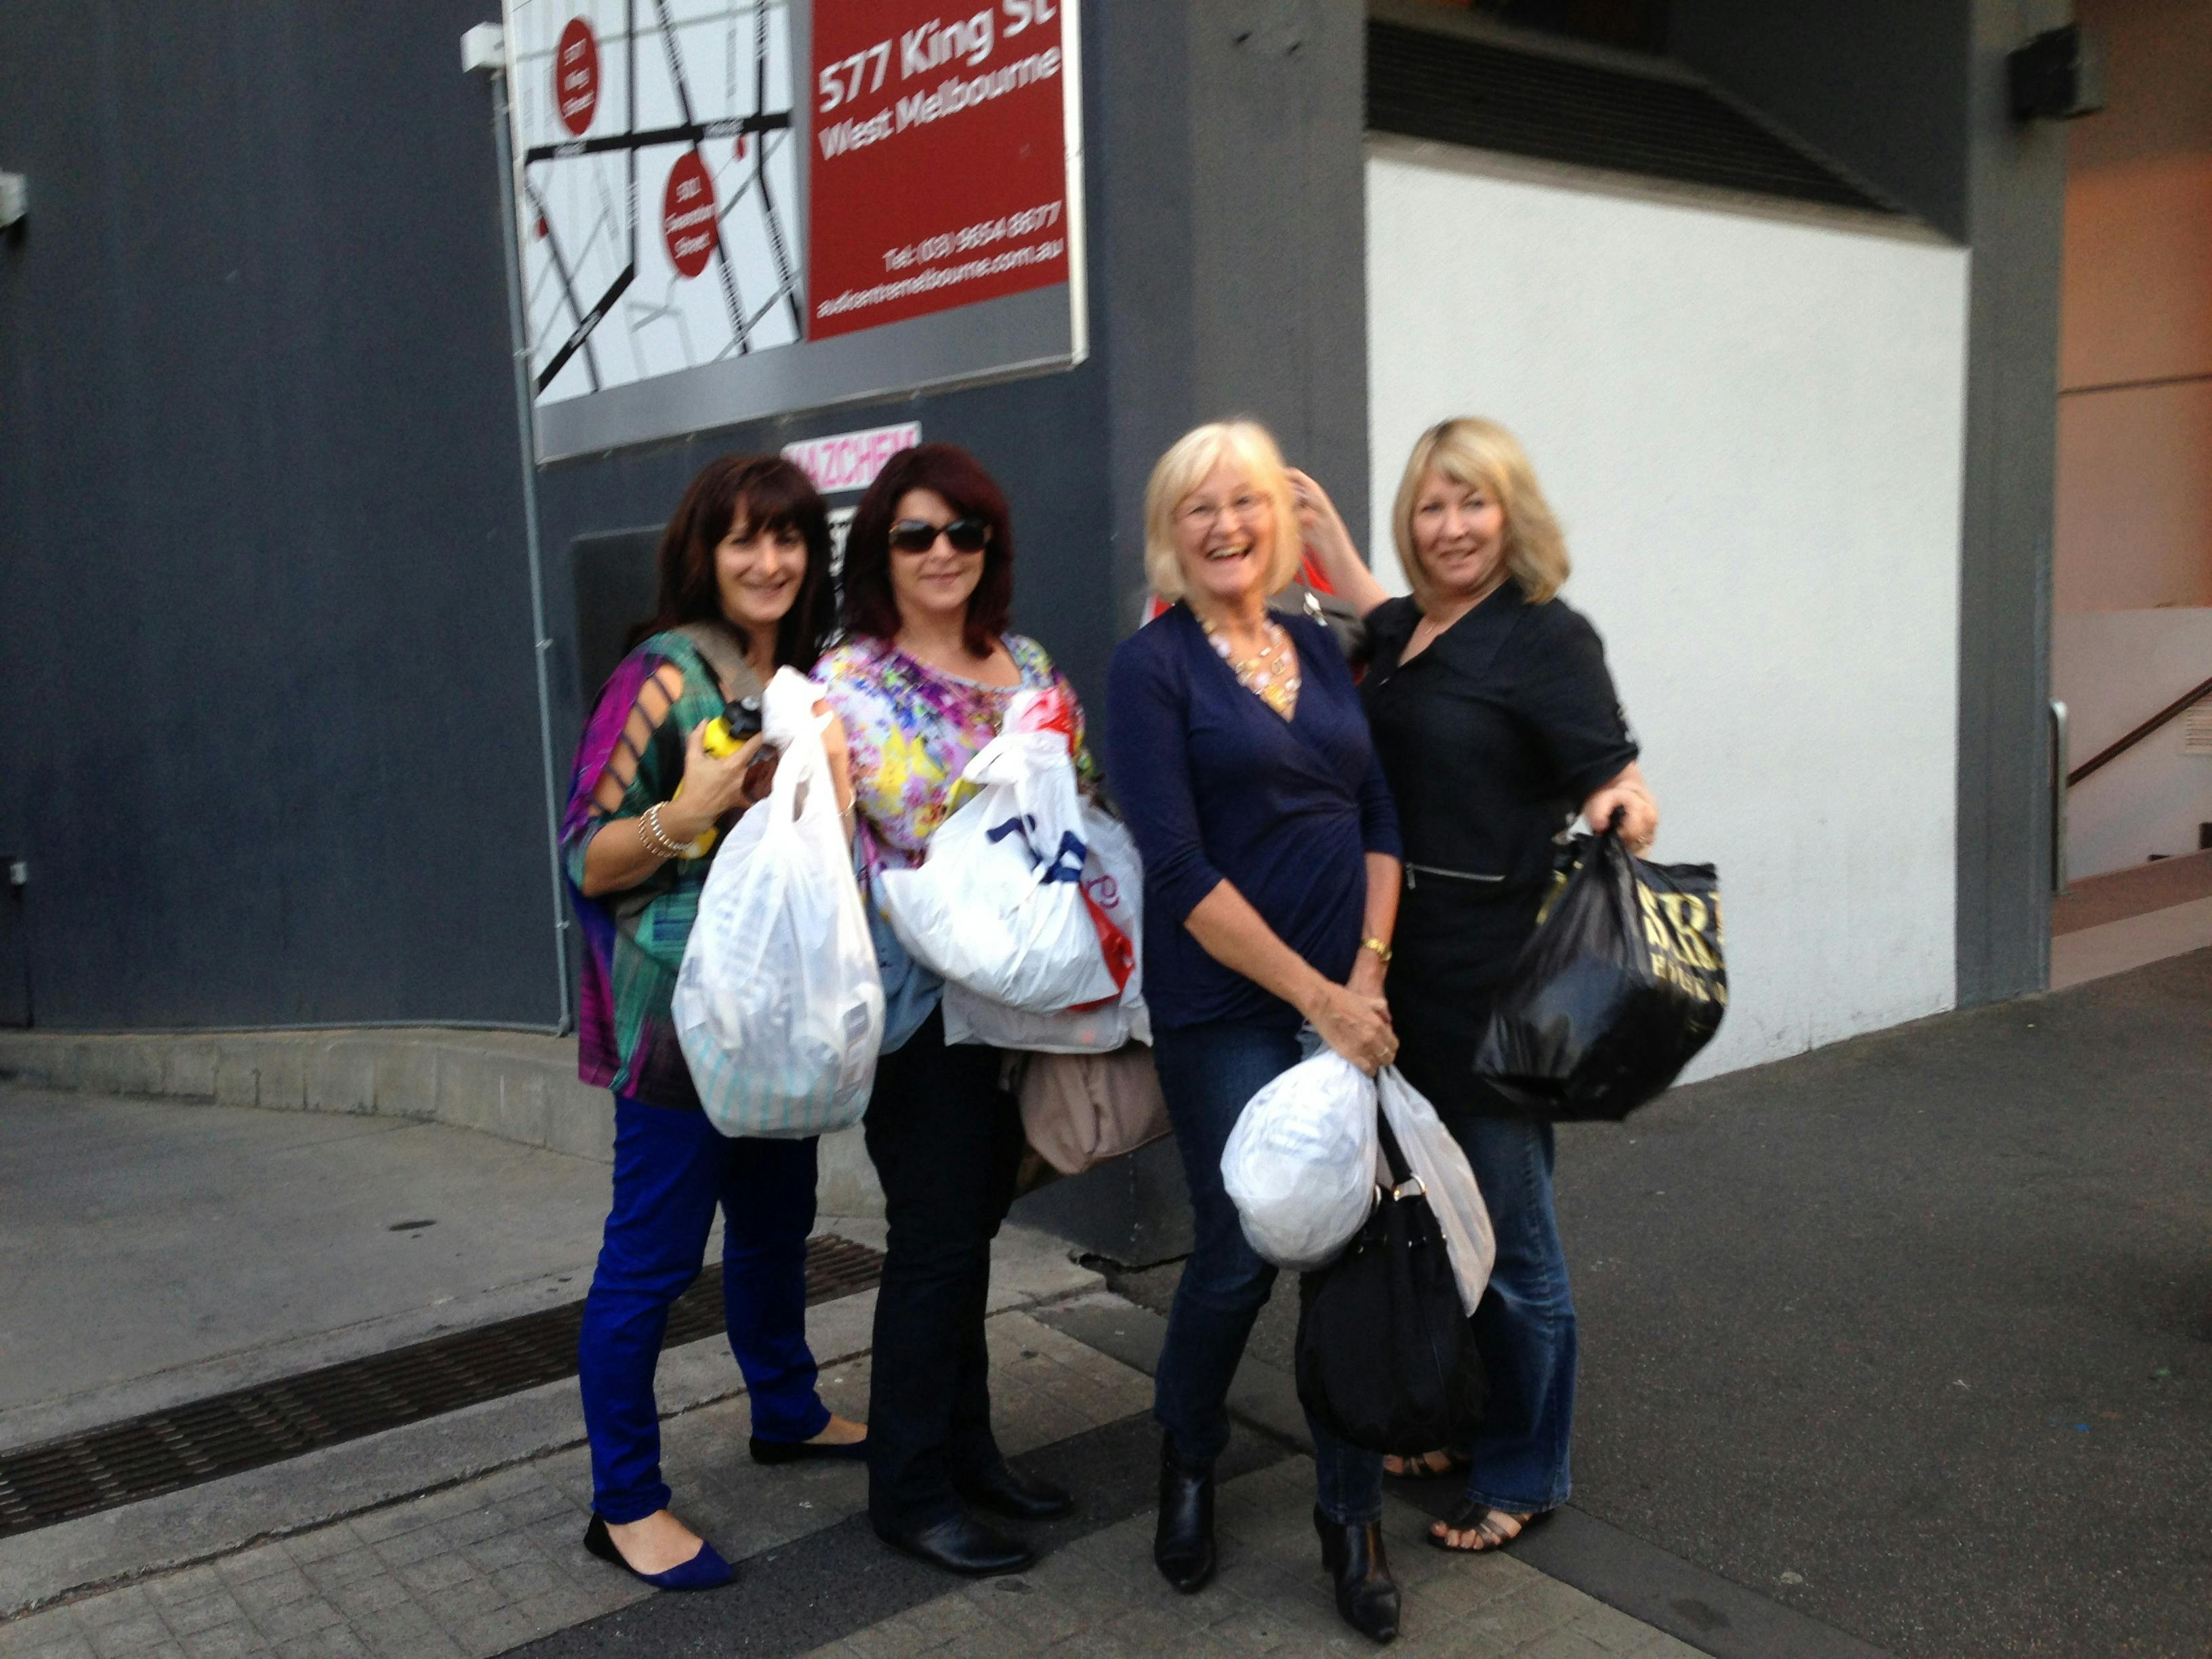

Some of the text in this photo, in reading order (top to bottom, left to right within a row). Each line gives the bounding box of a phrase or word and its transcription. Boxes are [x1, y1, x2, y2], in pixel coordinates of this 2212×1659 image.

[818, 45, 1062, 161] West Melbourne
[819, 39, 893, 113] 577
[899, 7, 994, 80] King
[1002, 0, 1057, 39] St
